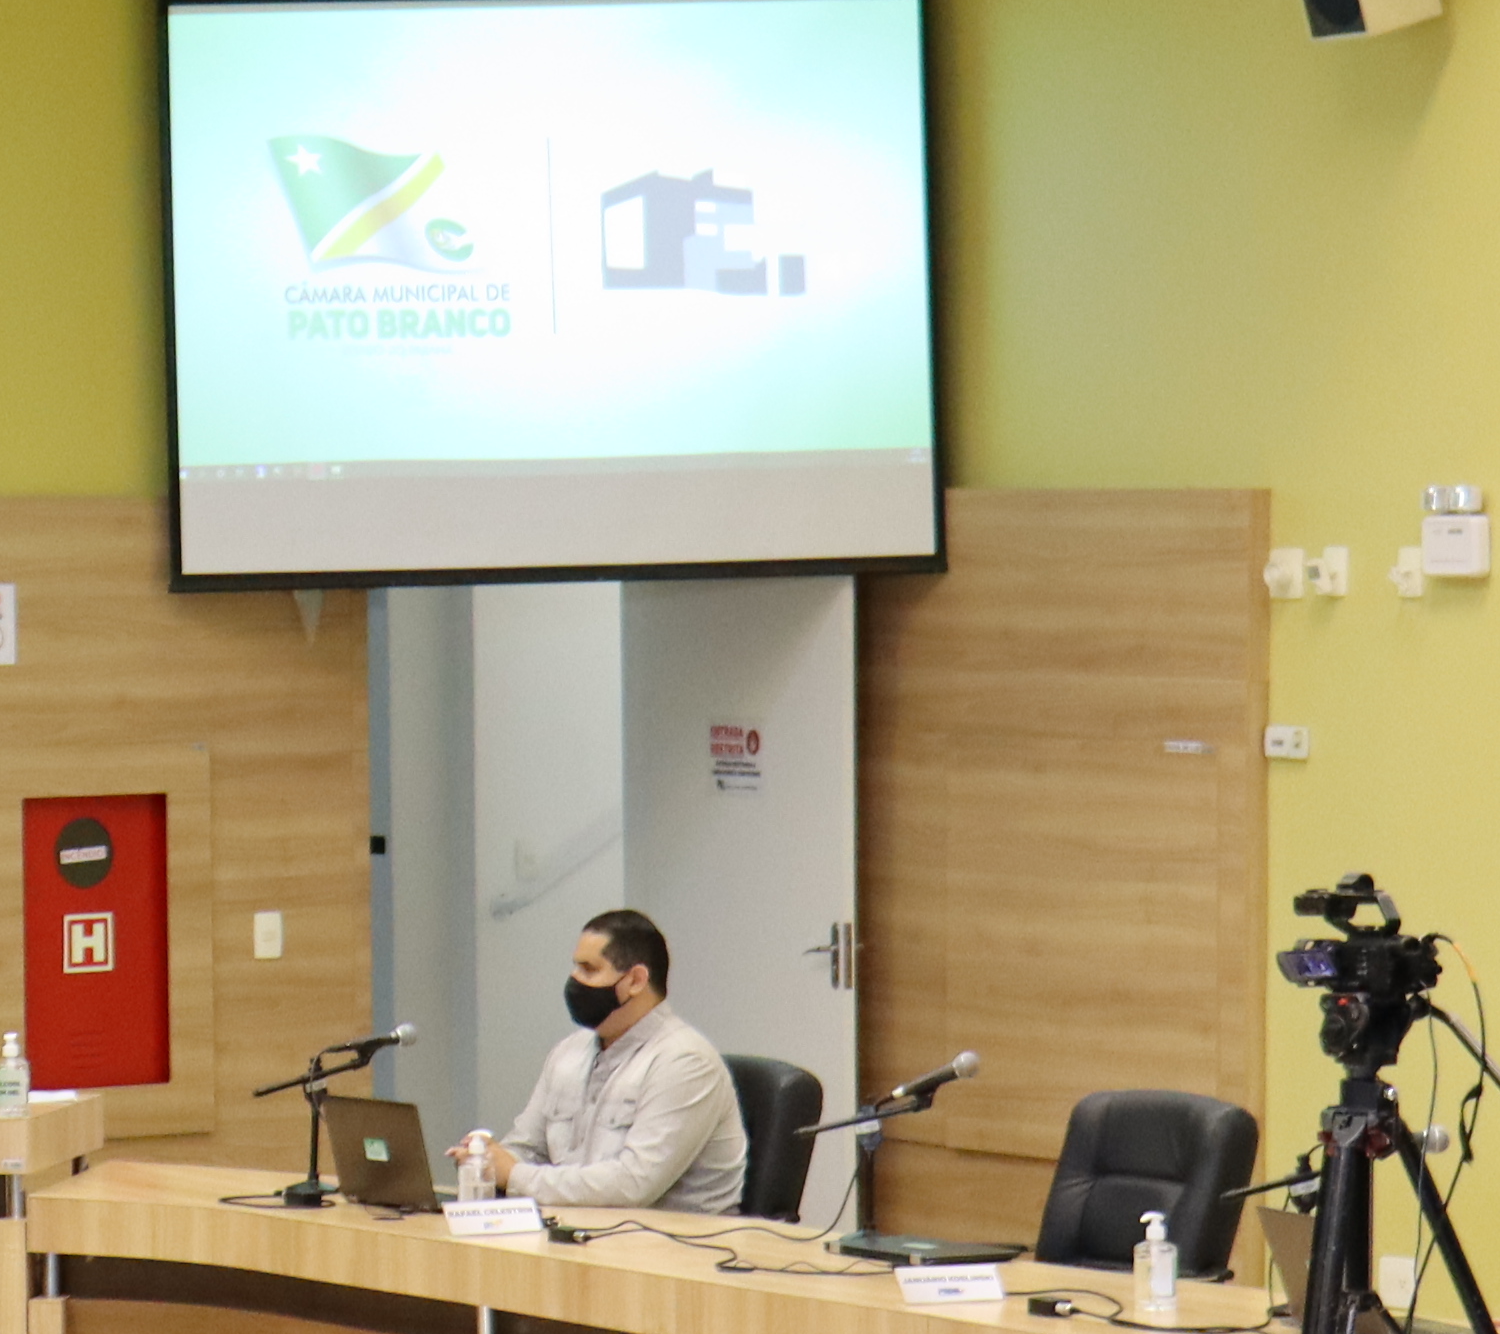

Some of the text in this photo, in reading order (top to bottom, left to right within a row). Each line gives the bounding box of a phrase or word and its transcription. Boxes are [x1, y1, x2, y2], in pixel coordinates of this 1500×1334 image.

[285, 281, 511, 304] CÂMARA MUNICIPAL DE
[288, 307, 511, 340] PATO BRANCO
[71, 921, 106, 964] H
